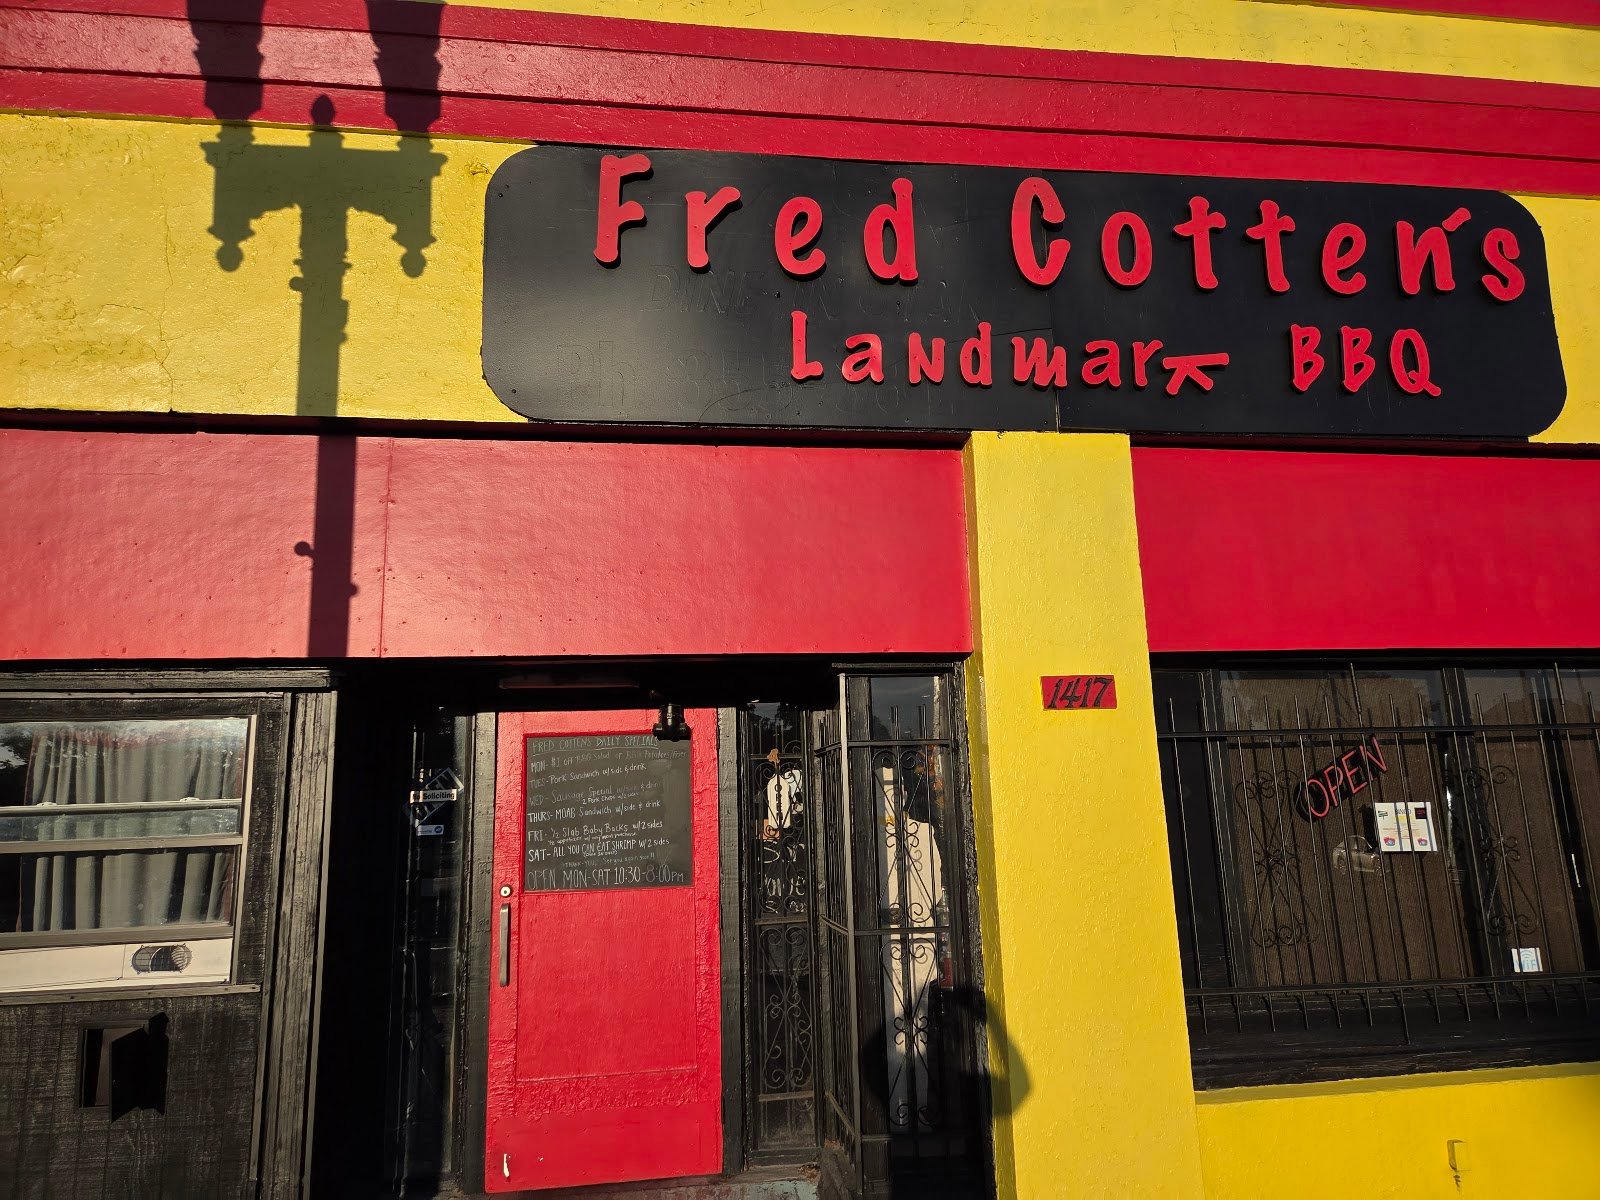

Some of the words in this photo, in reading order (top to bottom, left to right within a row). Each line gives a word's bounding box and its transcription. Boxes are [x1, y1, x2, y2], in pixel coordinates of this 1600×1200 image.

[593, 153, 920, 282] Fred
[1010, 175, 1527, 302] Cotten's
[1287, 323, 1443, 397] BBQ
[1047, 676, 1114, 709] 1417
[532, 740, 555, 754] FRED
[624, 735, 658, 747] SPECIALS
[569, 769, 600, 781] Sandwich
[1302, 735, 1388, 821] OPEN
[422, 791, 455, 800] Soliciting
[551, 789, 584, 804] Sausage
[588, 785, 613, 798] Special
[555, 806, 576, 820] MOAB
[579, 805, 612, 817] Sandwich
[645, 799, 661, 809] drink
[562, 827, 580, 838] Slab
[583, 824, 603, 836] Baby
[604, 822, 629, 833] Backs
[553, 846, 566, 858] ALL
[567, 844, 580, 855] YOU
[581, 843, 595, 854] CAN
[596, 841, 610, 852] EAT
[611, 839, 637, 851] SHRIMP
[527, 868, 557, 890] OPEN
[562, 868, 611, 889] MON-SAT
